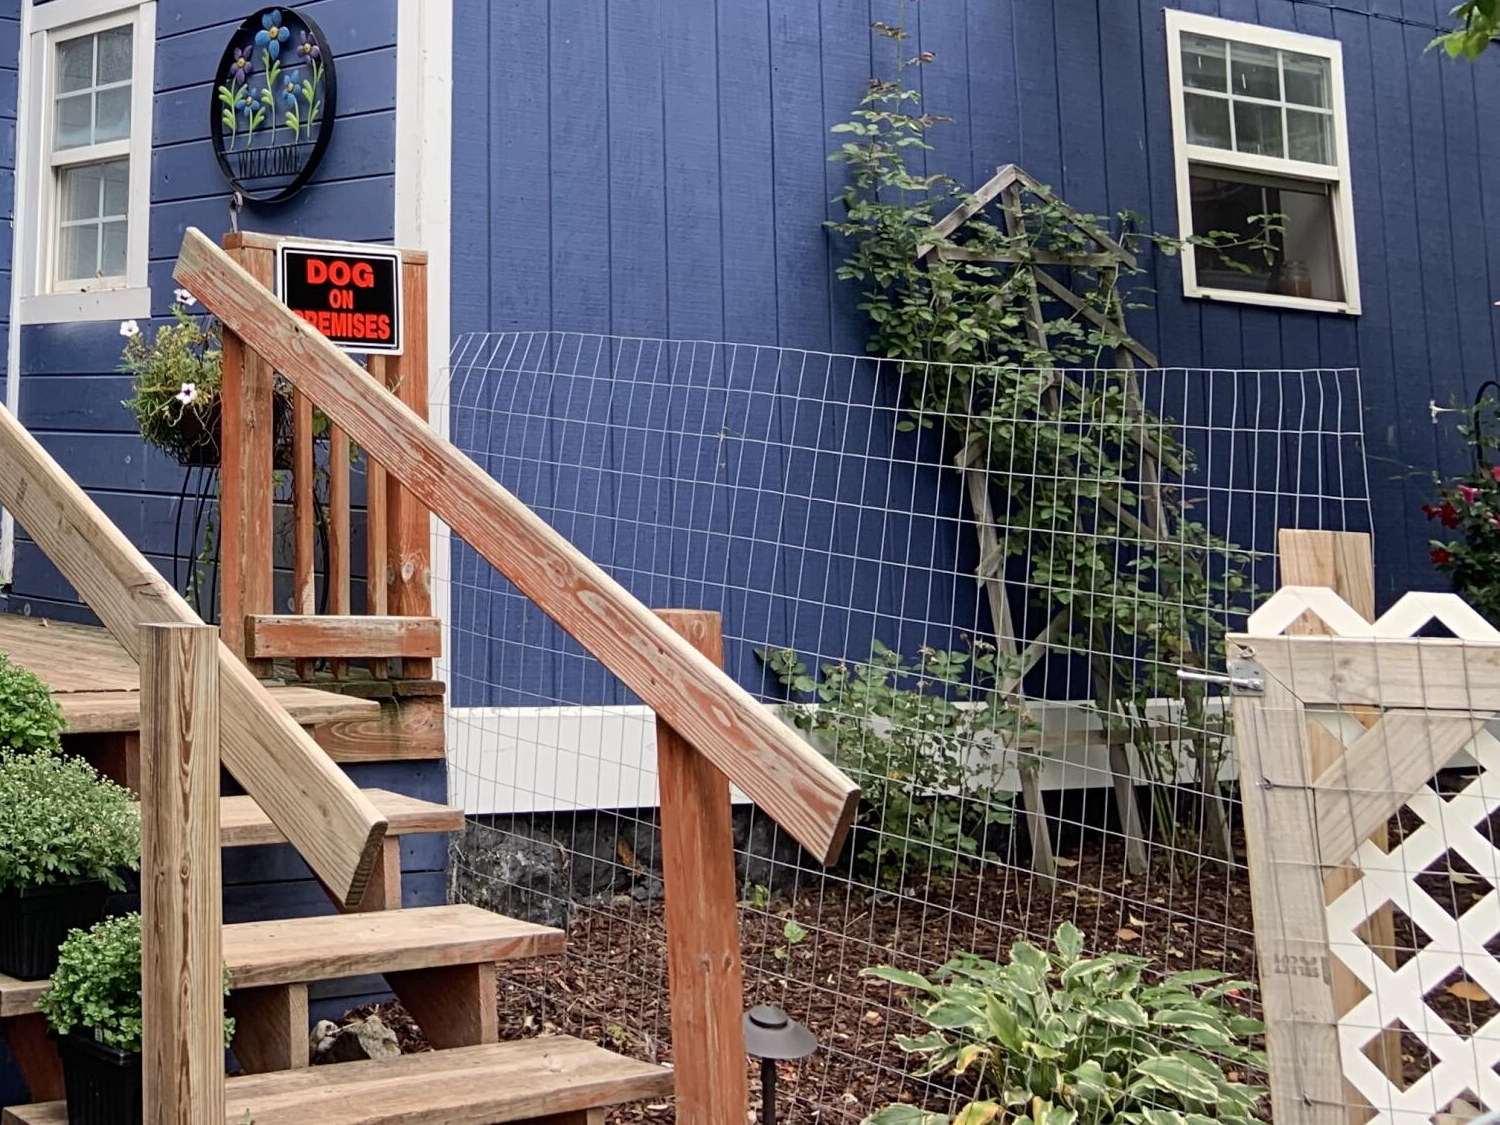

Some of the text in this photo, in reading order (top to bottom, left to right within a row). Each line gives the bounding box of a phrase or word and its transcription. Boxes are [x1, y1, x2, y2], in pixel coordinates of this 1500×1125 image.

[238, 145, 301, 179] WELCOME
[307, 259, 375, 288] DOG
[329, 289, 354, 309] ON
[294, 309, 391, 340] REMISES
